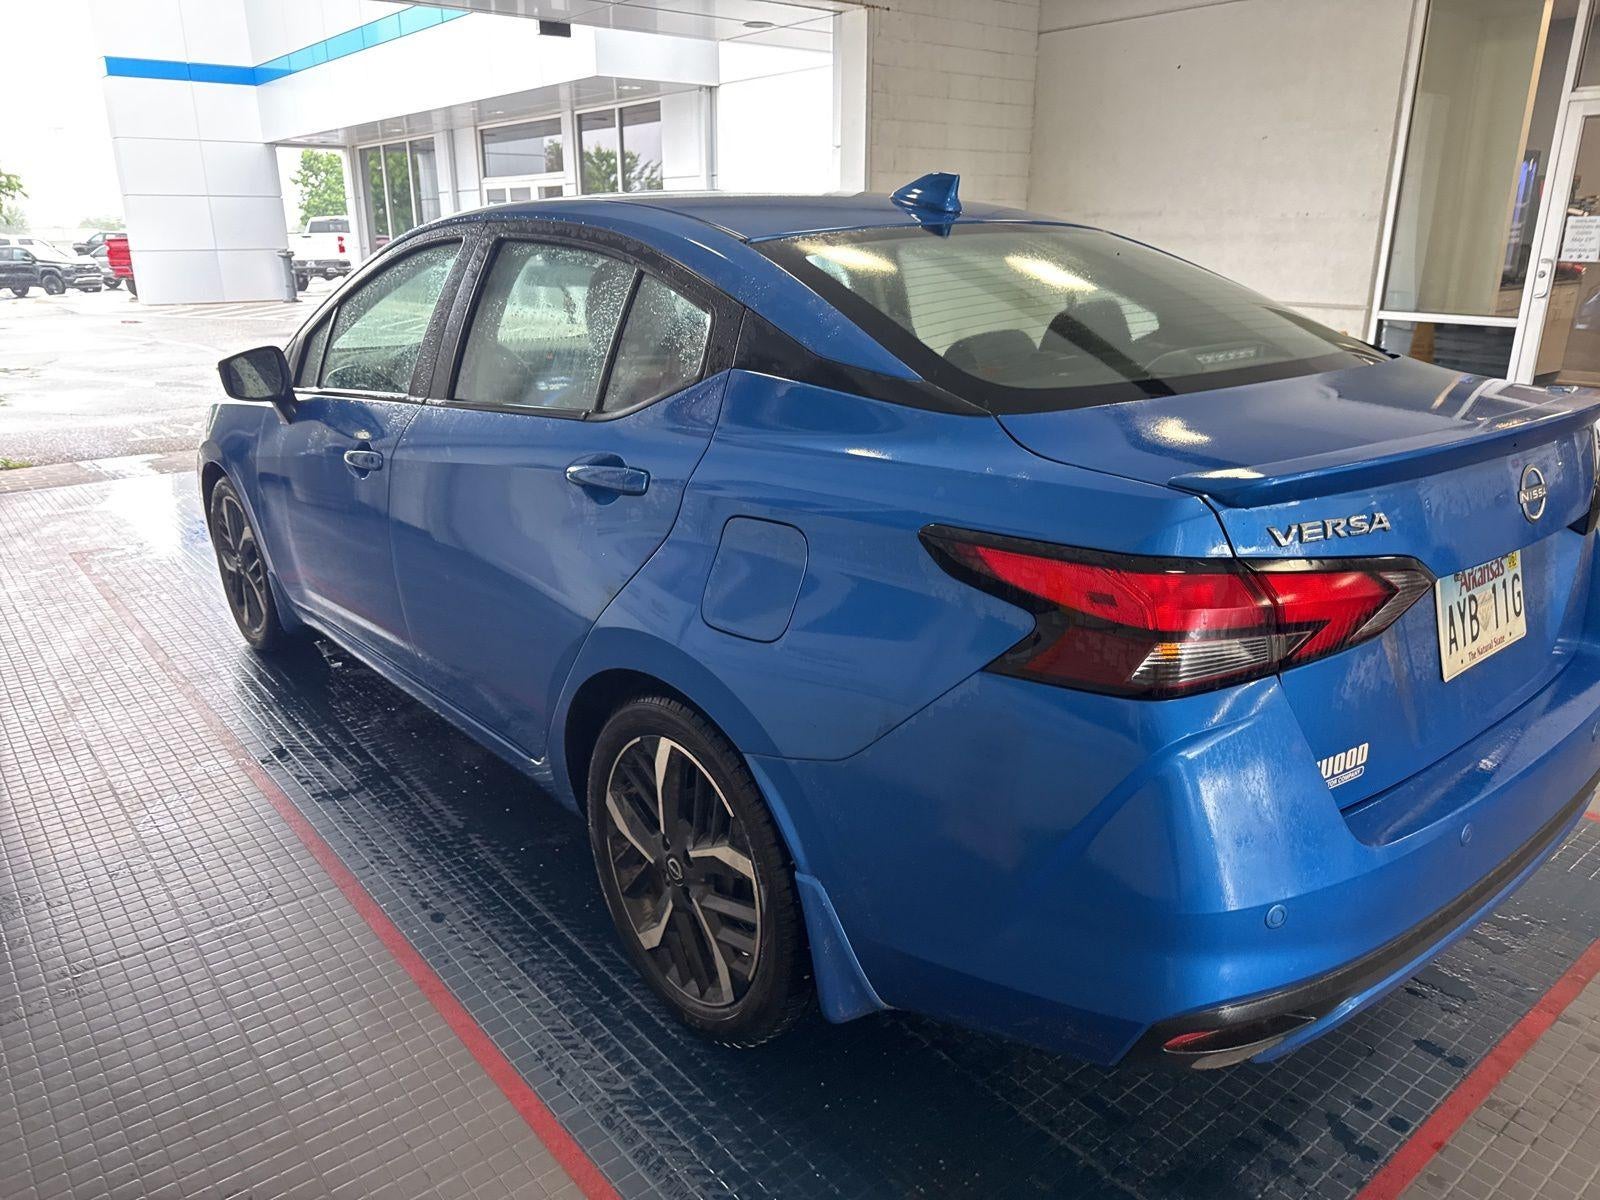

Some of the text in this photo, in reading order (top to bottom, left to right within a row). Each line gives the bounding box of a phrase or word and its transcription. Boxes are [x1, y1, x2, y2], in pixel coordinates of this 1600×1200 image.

[1521, 488, 1546, 502] NISSA
[1267, 512, 1391, 547] VERSA
[1459, 557, 1505, 596] Arkansas
[1449, 573, 1522, 656] AYB 11G
